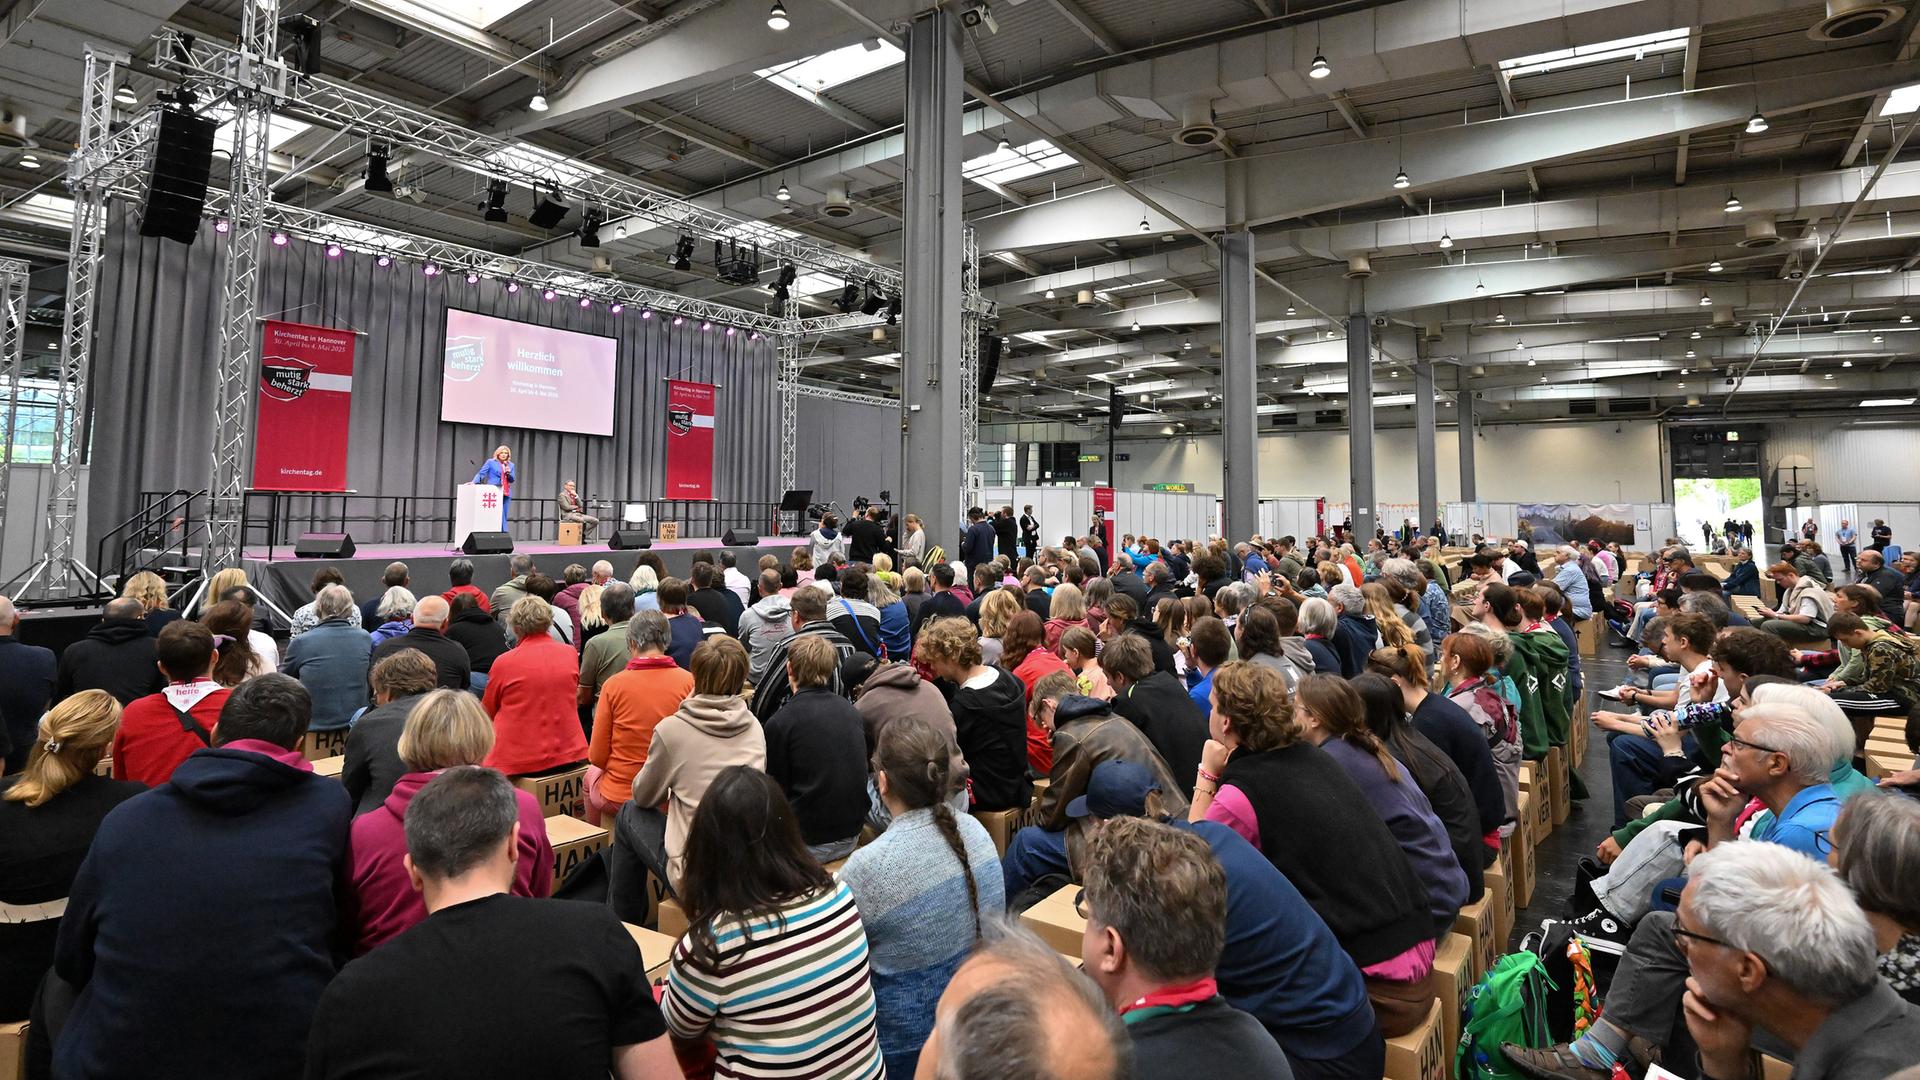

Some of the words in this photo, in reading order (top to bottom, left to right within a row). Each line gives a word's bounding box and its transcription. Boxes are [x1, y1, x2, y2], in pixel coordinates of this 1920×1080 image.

[274, 330, 308, 341] Kirchentag
[317, 337, 347, 346] Hannover
[285, 340, 300, 348] April
[452, 347, 475, 359] mutig
[464, 355, 484, 363] stark
[517, 348, 555, 362] Herzlich
[451, 360, 480, 372] beherzt
[507, 362, 563, 377] willkommen
[276, 371, 301, 380] mutig
[270, 379, 303, 396] beherzt
[287, 378, 310, 388] stark
[280, 468, 322, 477] kirchentag.de
[316, 731, 348, 750] HA
[1421, 1017, 1443, 1078] HAN
